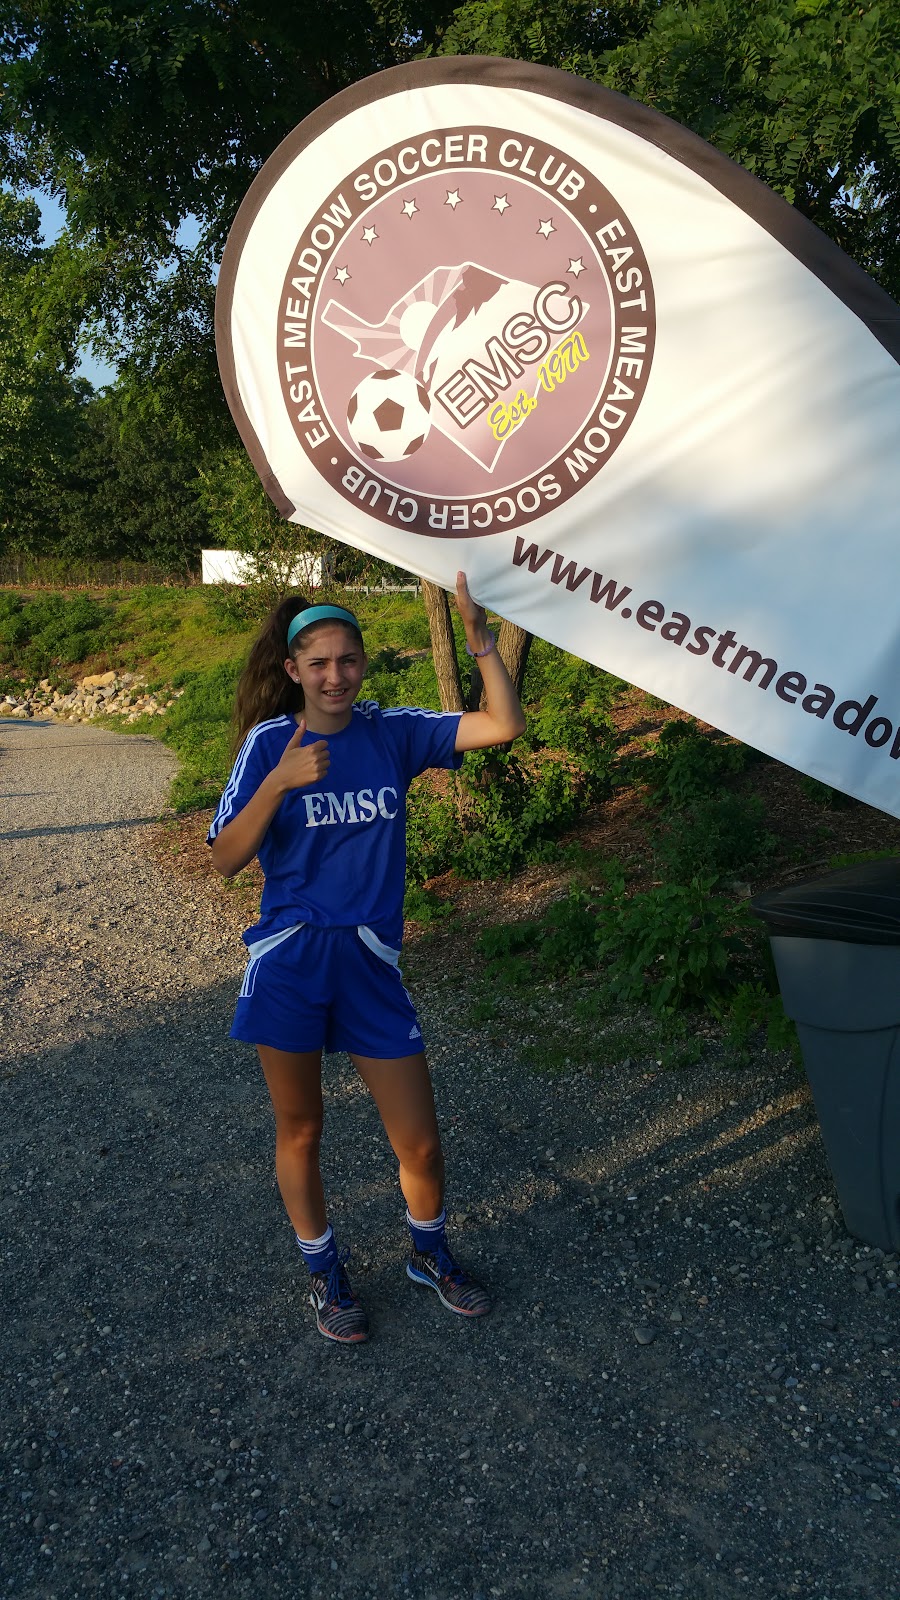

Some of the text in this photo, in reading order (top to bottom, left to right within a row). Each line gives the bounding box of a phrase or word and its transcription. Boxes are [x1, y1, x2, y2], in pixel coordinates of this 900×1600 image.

[283, 134, 586, 449] EAST MEADOW SOCCER CLUB
[341, 219, 648, 530] EAST MEADOW SOCCER CLUB
[434, 280, 583, 429] EMSC
[487, 331, 590, 441] Est. 1971
[511, 535, 900, 761] www.eastmeado
[302, 786, 398, 828] EMSC
